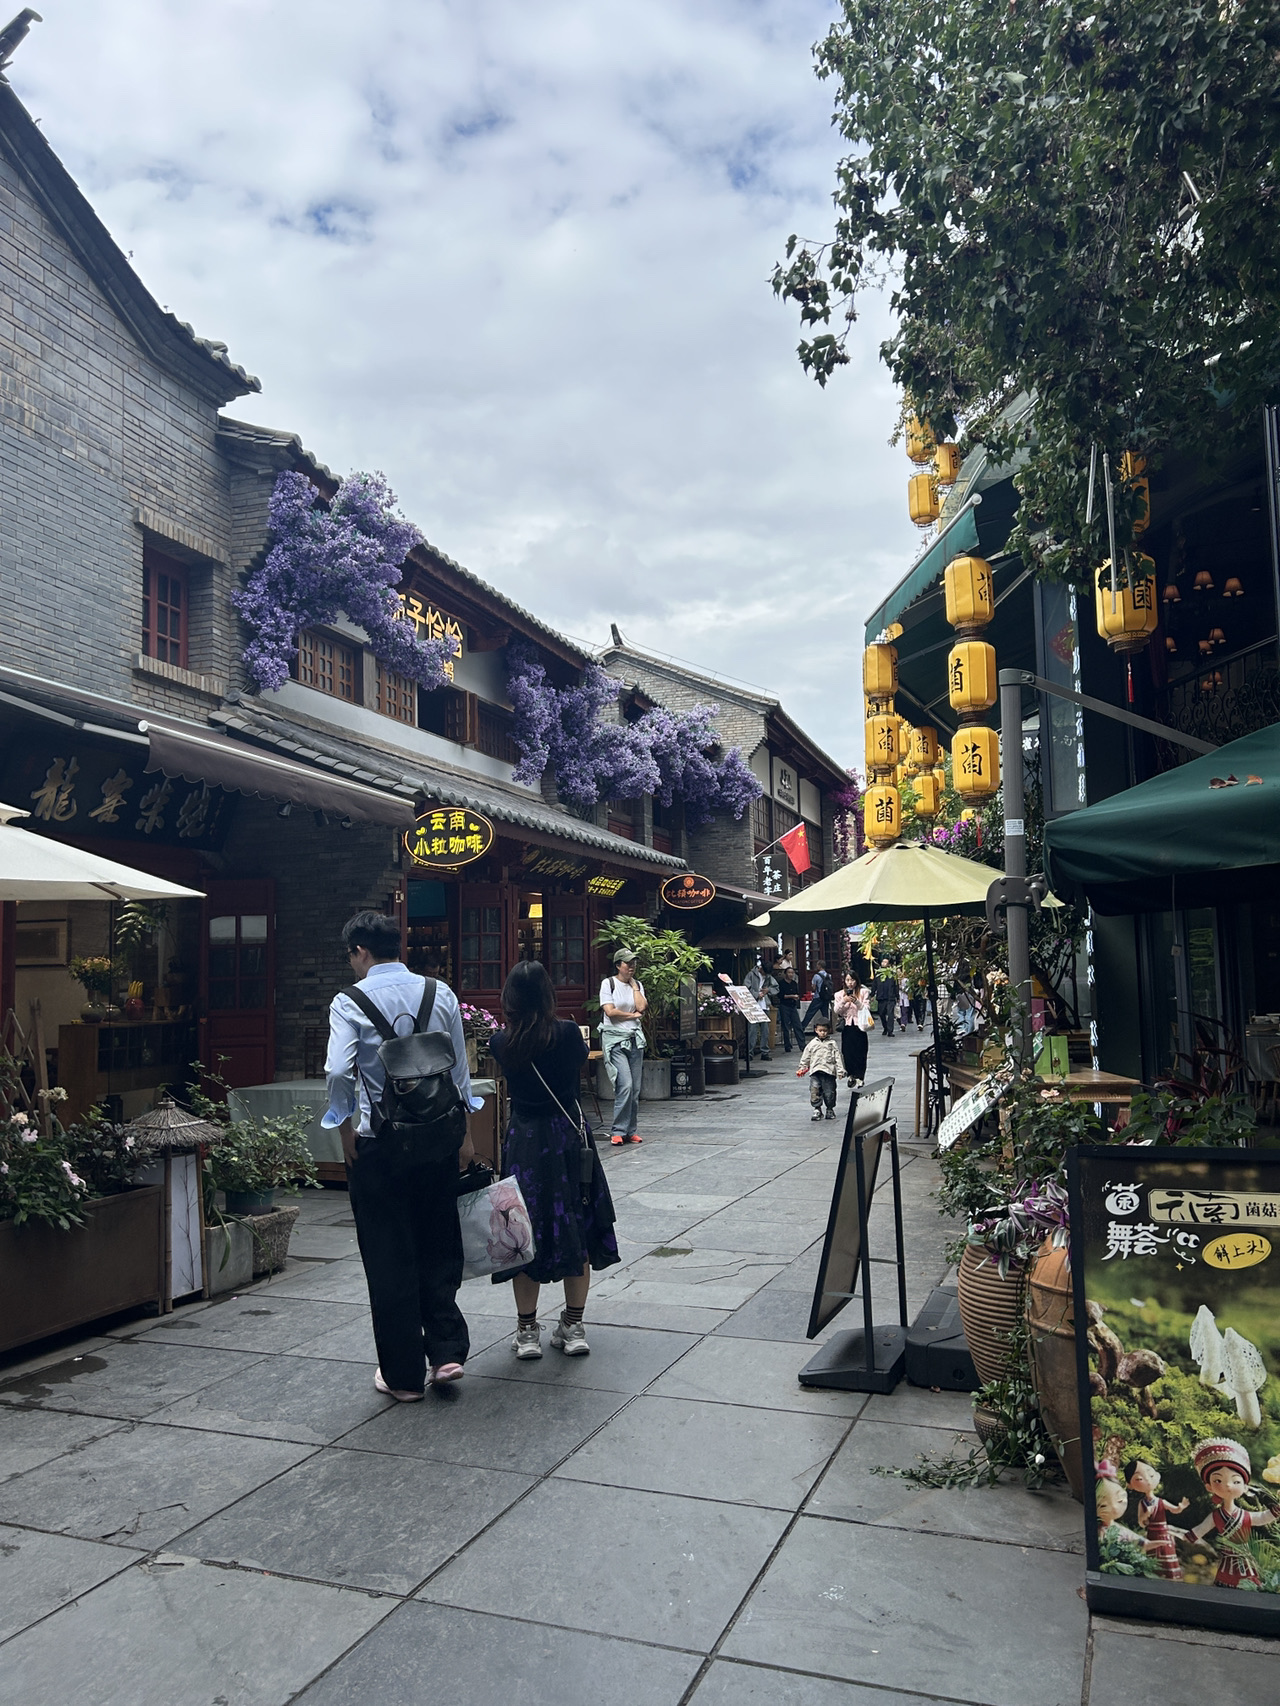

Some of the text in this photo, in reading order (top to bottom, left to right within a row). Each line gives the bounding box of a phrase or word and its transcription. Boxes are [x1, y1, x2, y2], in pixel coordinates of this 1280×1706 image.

[430, 811, 466, 831] 云南
[414, 834, 484, 856] 小粒咖啡
[1156, 1190, 1240, 1224] 云南
[1245, 1202, 1280, 1218] 菌菇
[1101, 1221, 1170, 1260] 舞荟
